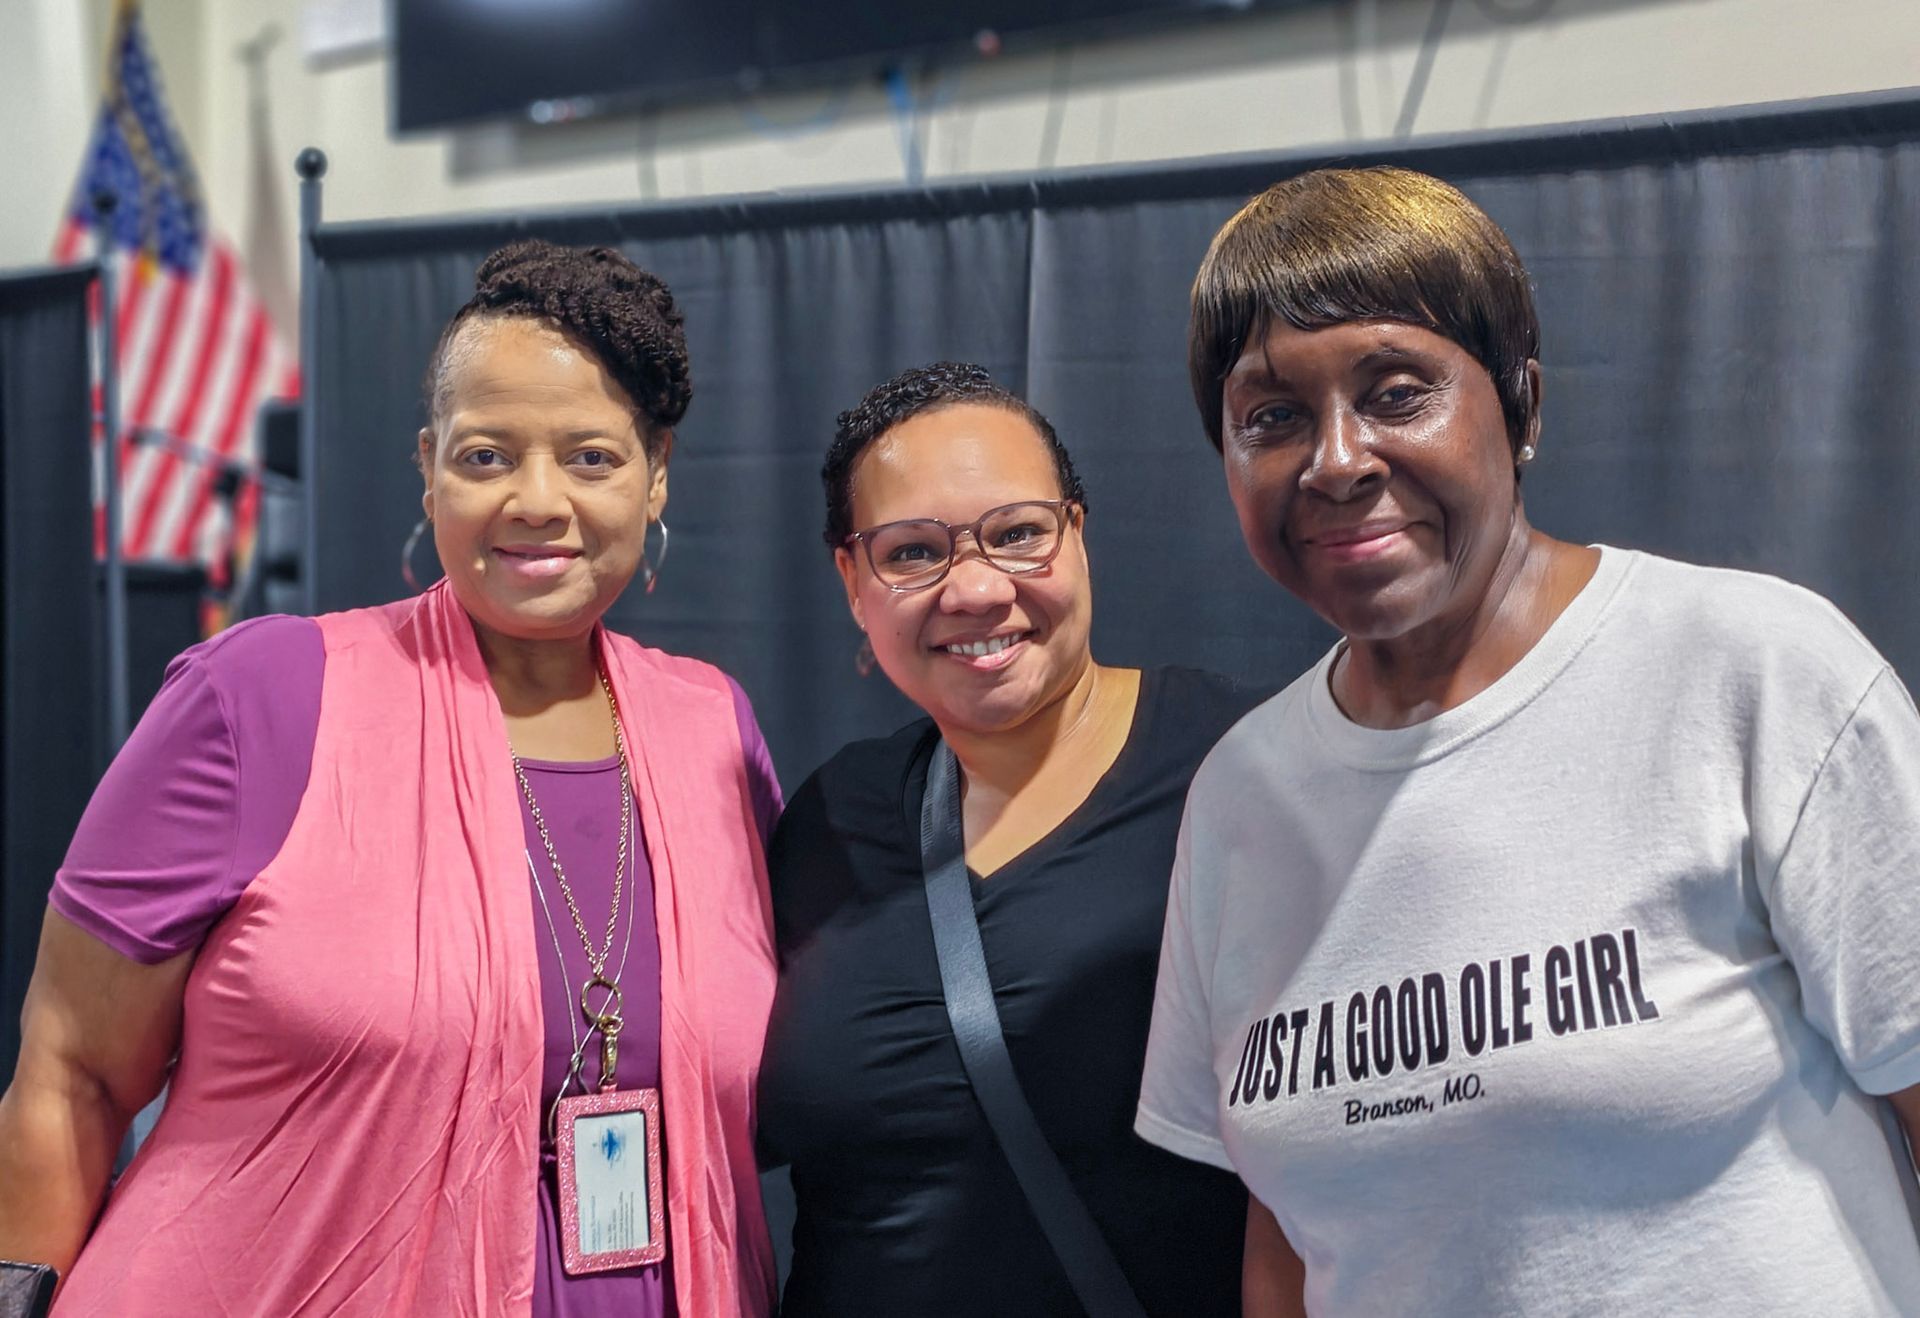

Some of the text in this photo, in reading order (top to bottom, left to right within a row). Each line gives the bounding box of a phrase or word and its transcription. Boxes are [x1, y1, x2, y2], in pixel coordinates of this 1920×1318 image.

[1229, 929, 1660, 1106] JUST A GOOD OLE GIRL
[1345, 1074, 1486, 1125] Branson, MO.
